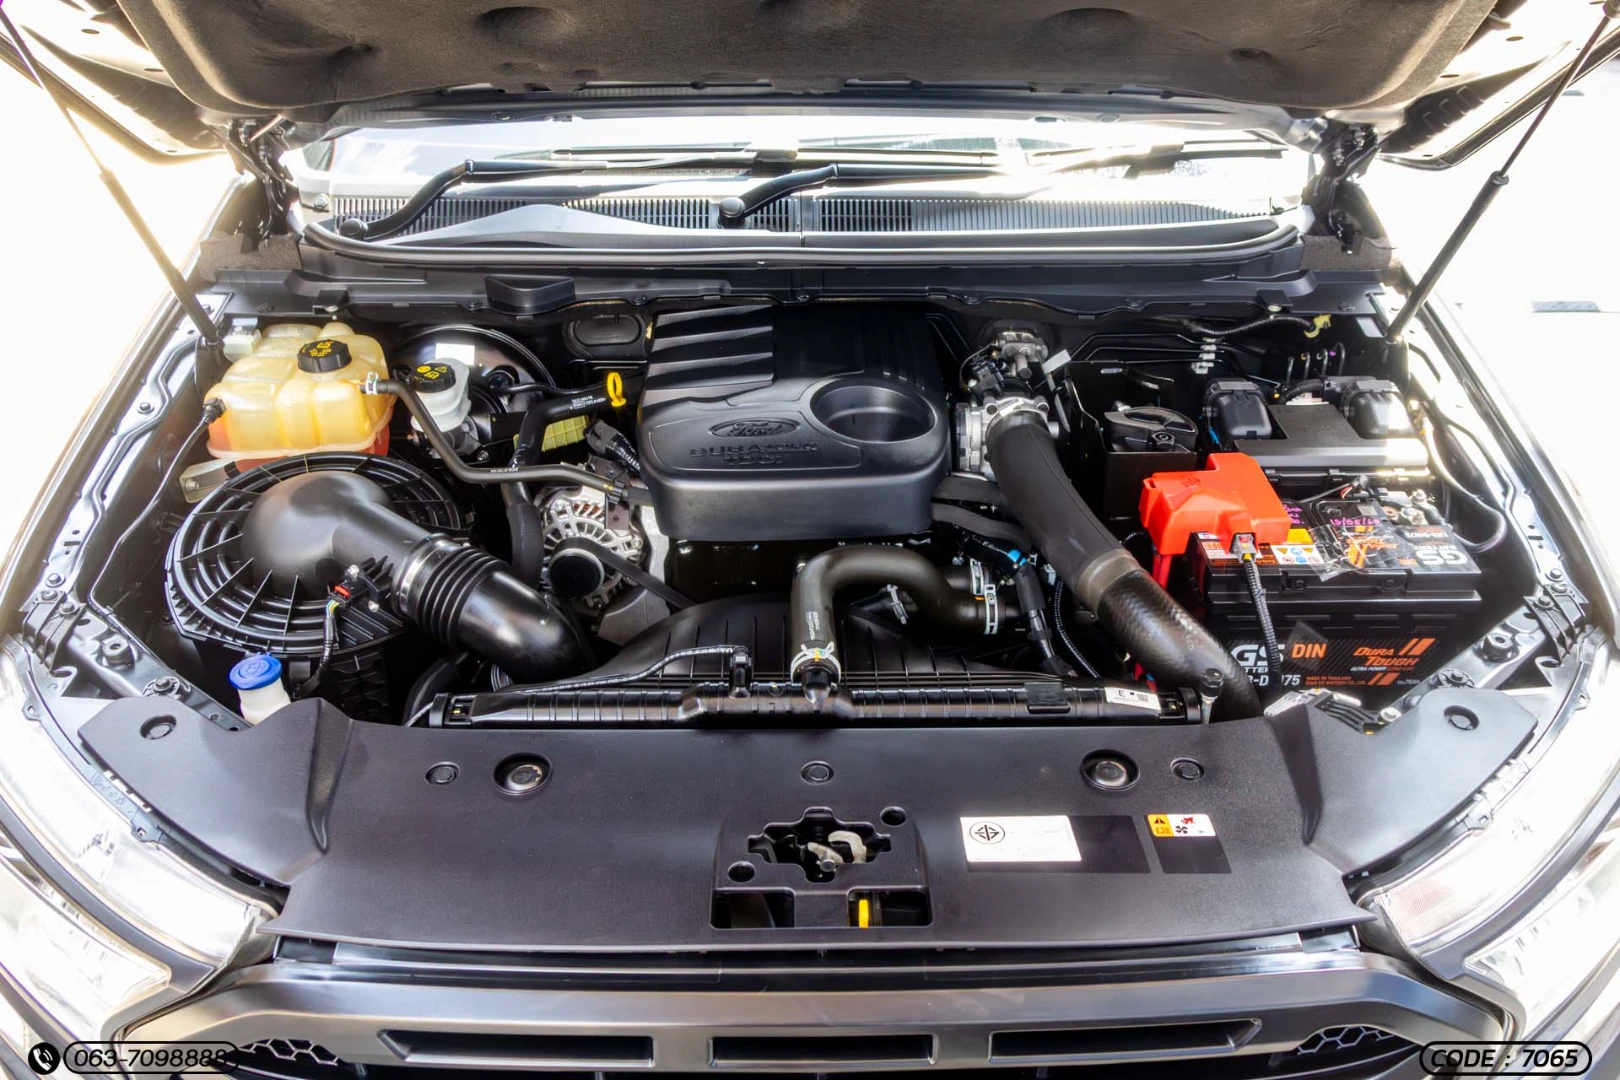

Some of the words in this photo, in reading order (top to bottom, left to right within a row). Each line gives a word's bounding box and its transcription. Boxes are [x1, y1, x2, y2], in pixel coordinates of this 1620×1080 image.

[1415, 550, 1468, 566] GS
[1291, 643, 1328, 659] DIN
[1353, 647, 1395, 656] DURA
[1365, 656, 1420, 666] TOUGH
